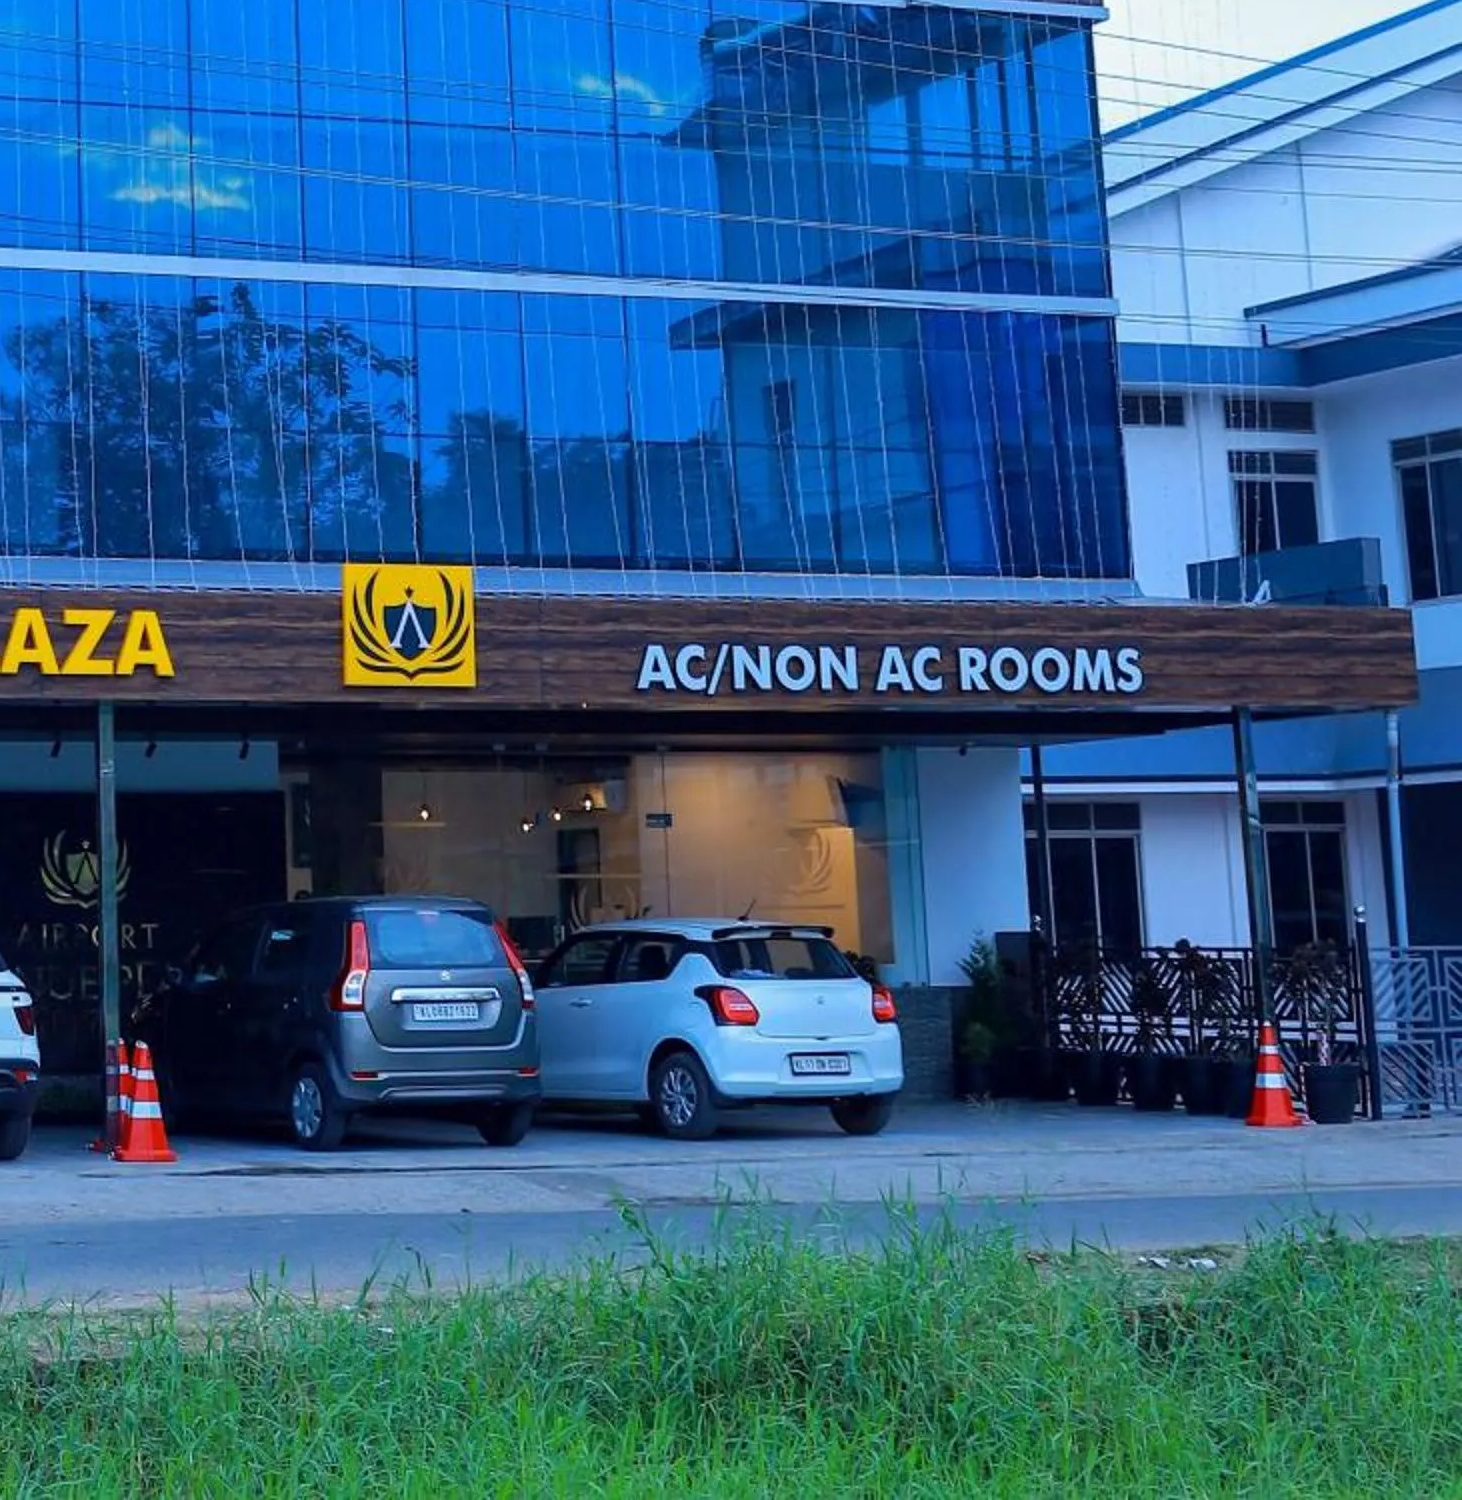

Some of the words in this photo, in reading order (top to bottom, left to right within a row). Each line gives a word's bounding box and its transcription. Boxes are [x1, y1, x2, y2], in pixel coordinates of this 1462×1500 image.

[636, 643, 859, 695] AC/NON
[875, 645, 944, 692] AC
[958, 647, 1144, 693] ROOMS
